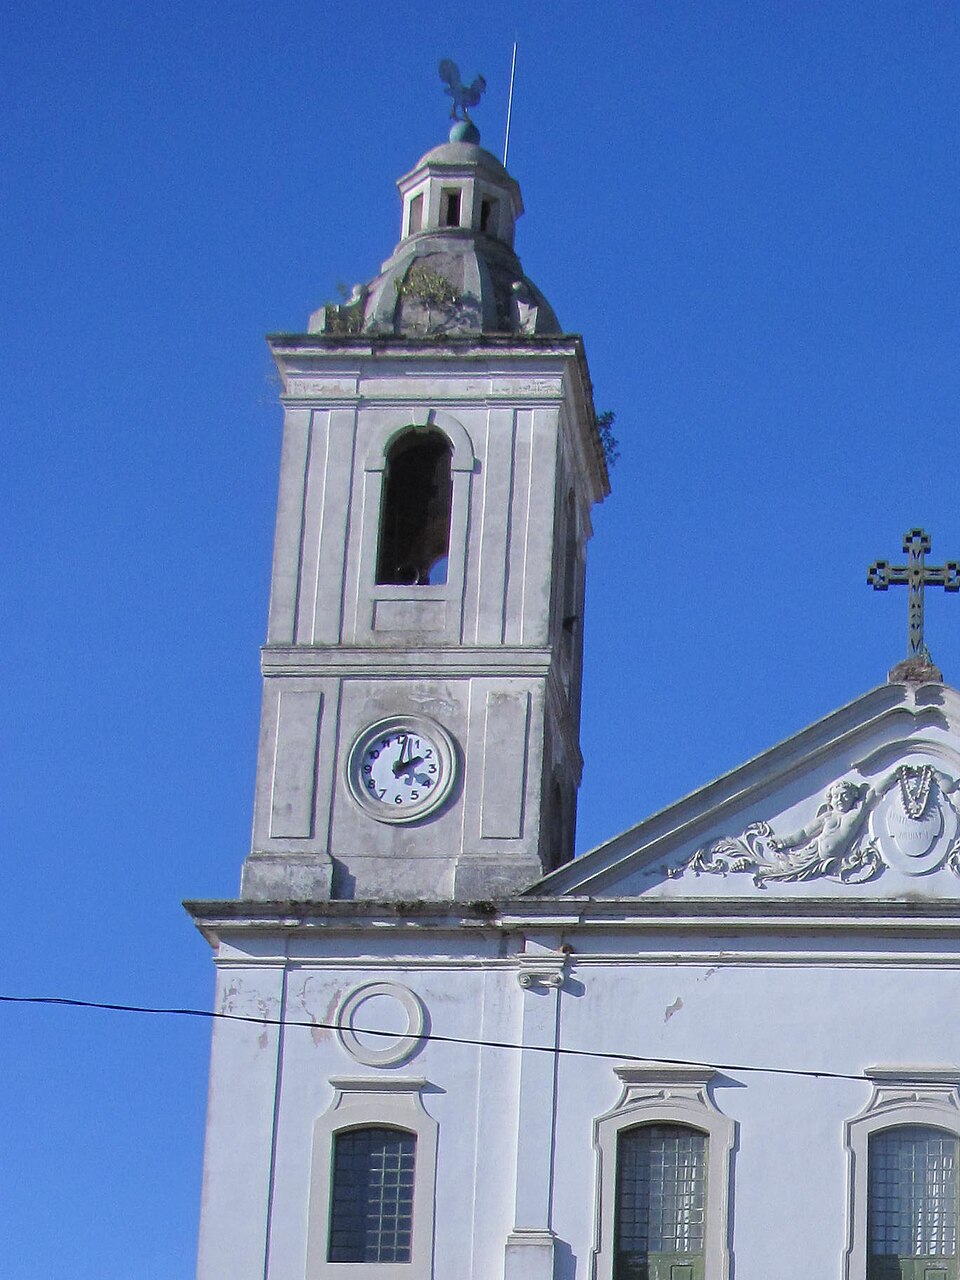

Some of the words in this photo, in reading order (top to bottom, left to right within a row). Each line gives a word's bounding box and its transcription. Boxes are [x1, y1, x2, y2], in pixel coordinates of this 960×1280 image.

[382, 739, 390, 747] 11
[415, 740, 420, 748] 1
[370, 750, 379, 759] 10
[425, 749, 432, 759] 2
[364, 765, 372, 773] 9
[429, 764, 437, 773] 3
[368, 780, 375, 789] 8
[422, 780, 431, 788] 4
[379, 789, 387, 799] 7
[411, 791, 419, 800] 5
[395, 795, 402, 804] 6
